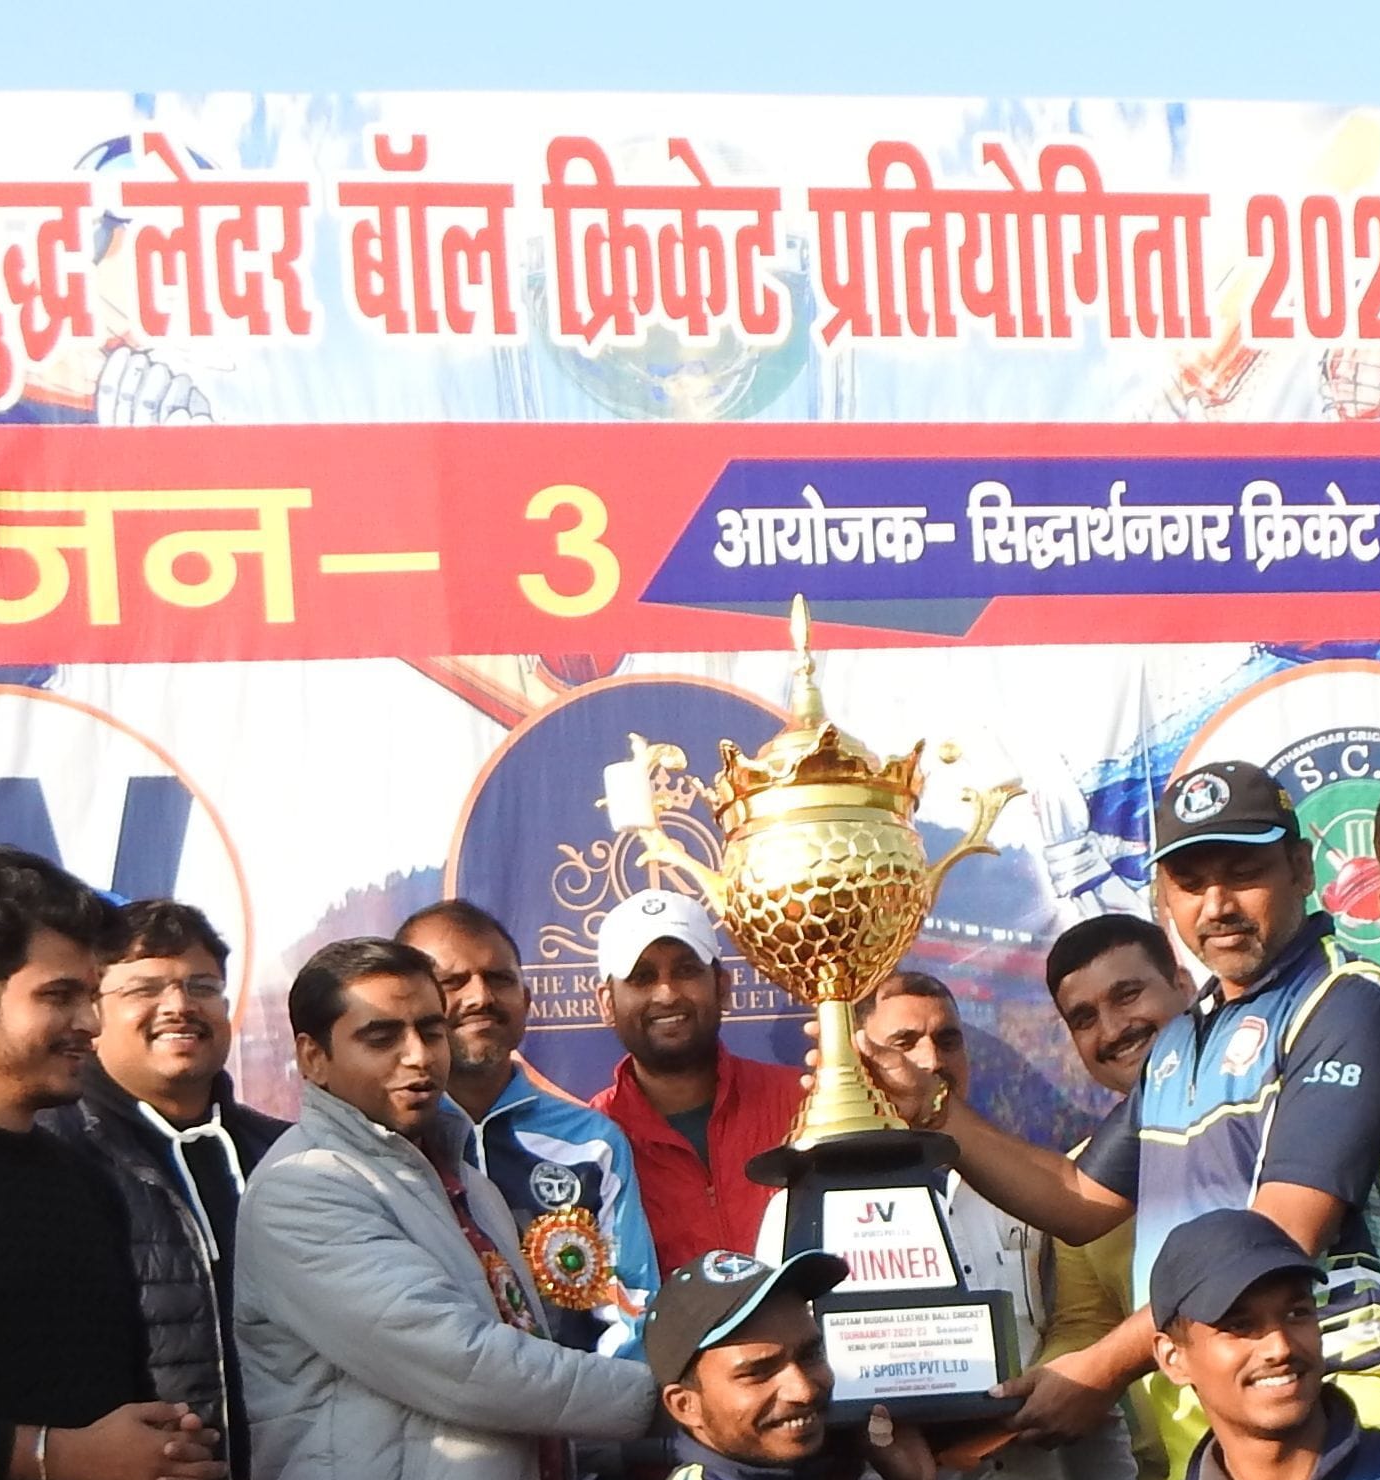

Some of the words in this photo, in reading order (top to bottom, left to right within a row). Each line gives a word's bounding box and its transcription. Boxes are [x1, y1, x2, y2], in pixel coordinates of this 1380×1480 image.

[121, 131, 312, 337] लेदर
[338, 134, 517, 335] बॉल
[542, 136, 782, 345] क्रिकेट
[809, 140, 1212, 347] प्रतियोगिता
[967, 481, 1232, 570] सिद्धार्थनगर
[1240, 480, 1380, 573] क्रिकेट
[518, 484, 621, 618] 3
[524, 975, 567, 995] HE
[857, 1201, 895, 1224] JV
[830, 1316, 862, 1327] GAUTAM
[863, 1315, 894, 1325] BUDDHA
[896, 1313, 930, 1323] LEATHER
[932, 1311, 950, 1321] BALL
[873, 1361, 917, 1378] SPORTS
[919, 1359, 940, 1374] PVT
